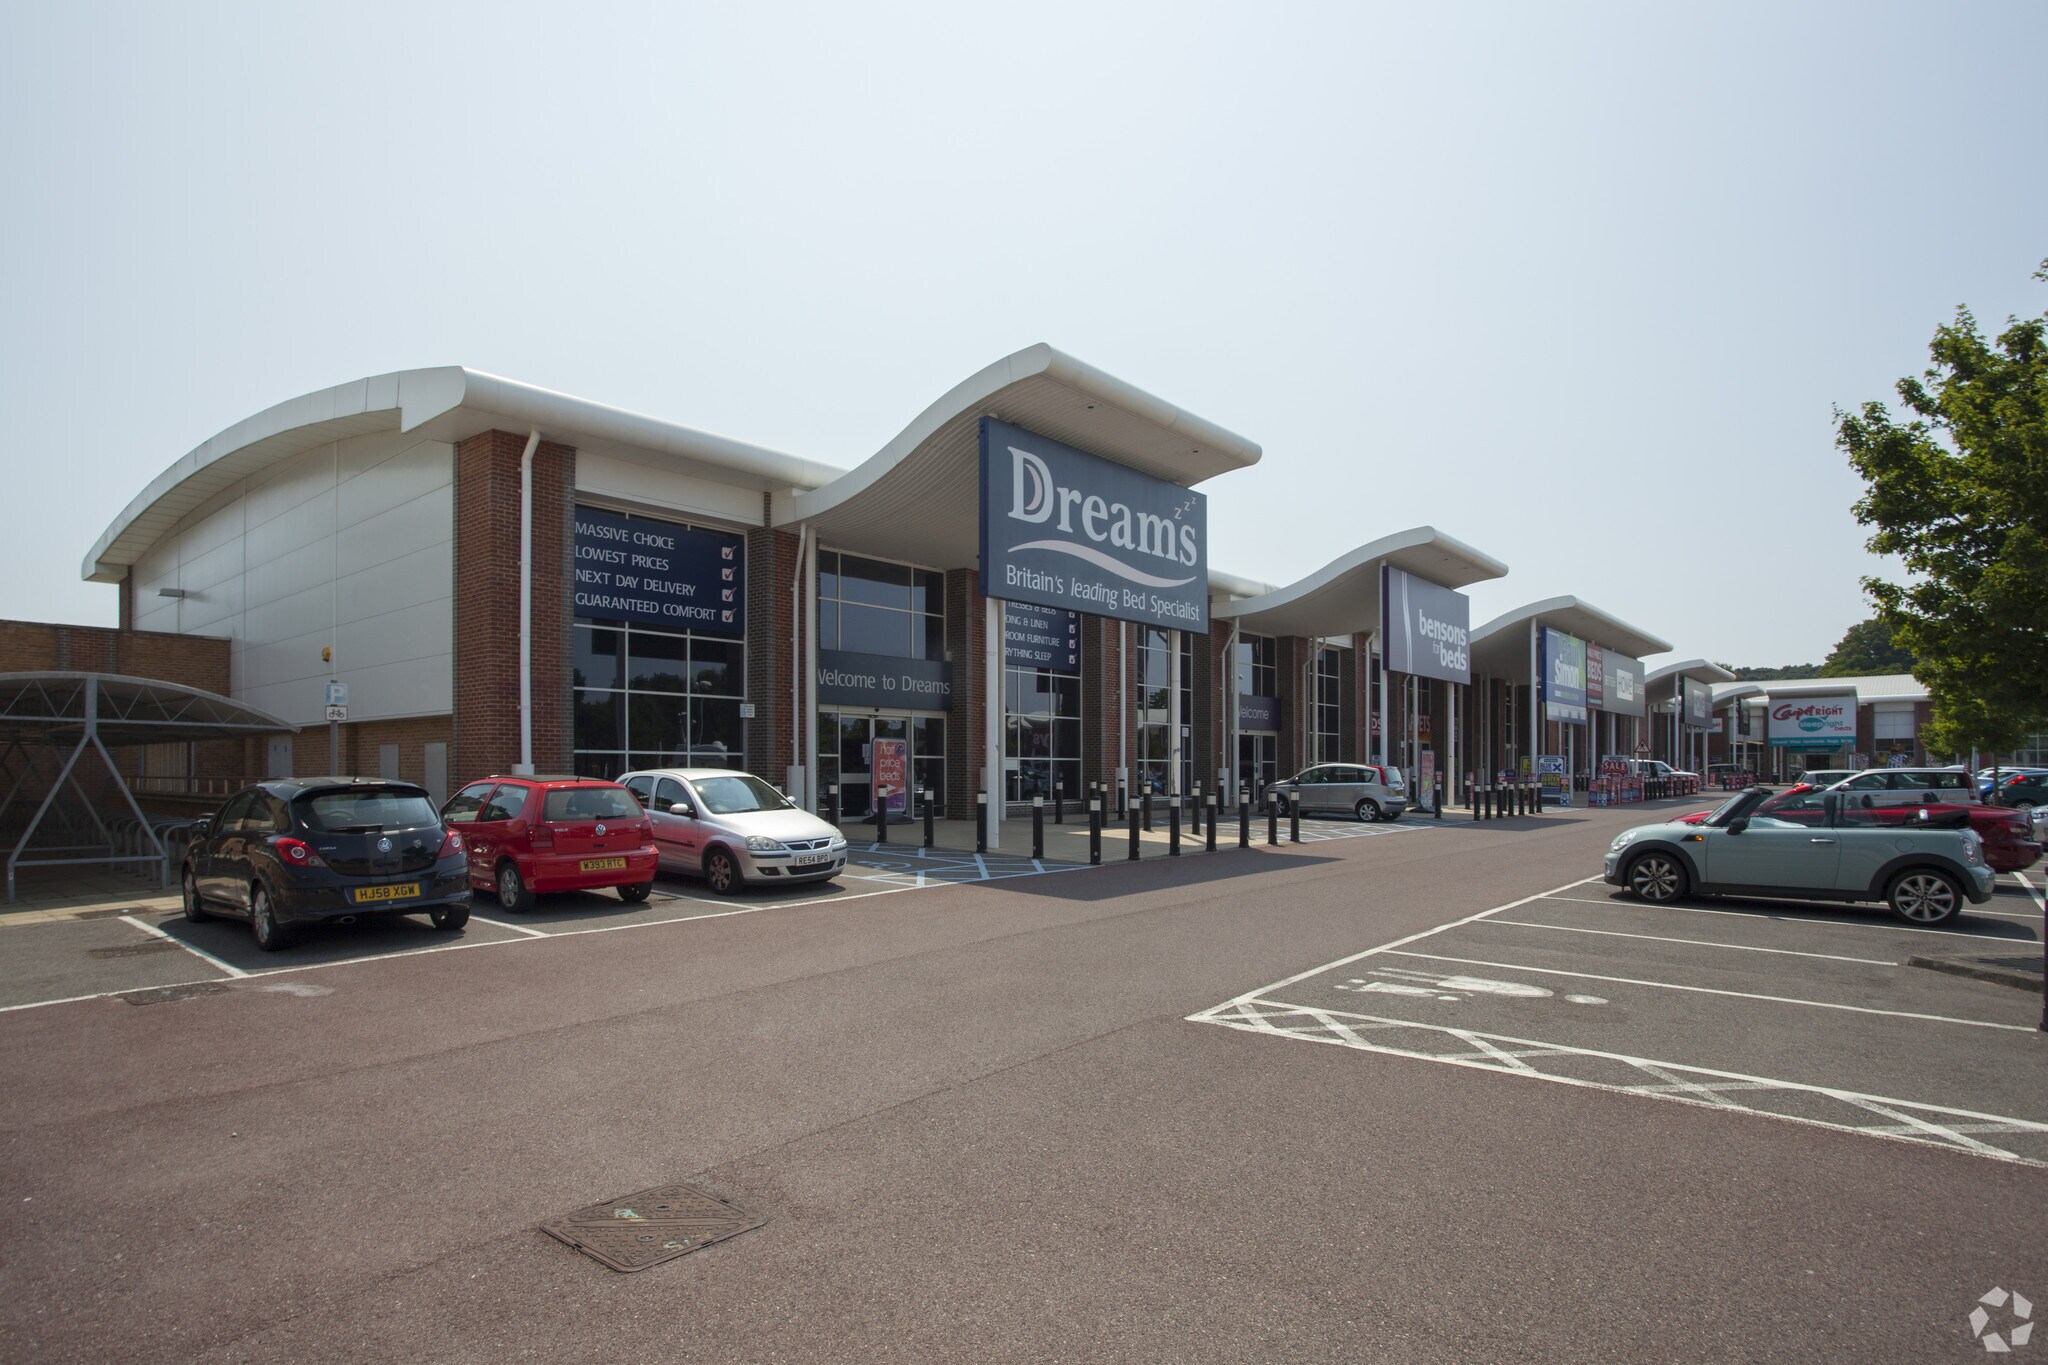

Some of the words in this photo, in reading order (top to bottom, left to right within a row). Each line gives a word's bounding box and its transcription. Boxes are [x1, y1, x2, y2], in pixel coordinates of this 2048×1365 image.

[1007, 446, 1197, 567] Dreams
[575, 521, 629, 543] MASSIVE
[633, 532, 675, 550] CHOICE
[575, 545, 627, 564] LOWEST
[631, 554, 669, 571] PRICES
[575, 568, 611, 585] NEXT
[616, 574, 639, 589] DAY
[643, 578, 696, 597] DELIVERY
[1006, 564, 1064, 594] Britain's
[1070, 577, 1119, 610] leading
[1123, 589, 1145, 611] Bed
[1150, 595, 1200, 621] Specialist
[575, 592, 659, 613] GUARANTEED
[662, 603, 717, 621] COMFORT
[1023, 617, 1028, 627] &
[1030, 619, 1048, 629] LINEN
[1419, 608, 1467, 647] bensons
[1027, 633, 1060, 647] FURNITURE
[1034, 650, 1052, 661] SLEEP
[1432, 641, 1440, 654] for
[1440, 641, 1467, 671] beds
[1554, 654, 1580, 689] Simon
[1587, 659, 1602, 681] BEDS
[330, 685, 345, 703] P
[882, 675, 896, 690] to
[902, 676, 950, 695] Dreams
[1238, 704, 1269, 720] elcome
[880, 744, 895, 754] Half
[880, 758, 900, 772] price
[1604, 760, 1627, 771] SALE
[880, 770, 900, 782] beds
[583, 861, 606, 869] W393
[607, 859, 623, 868] RTC
[798, 856, 815, 864] RE54
[360, 887, 391, 900] HJ58
[393, 885, 415, 897] XGW
